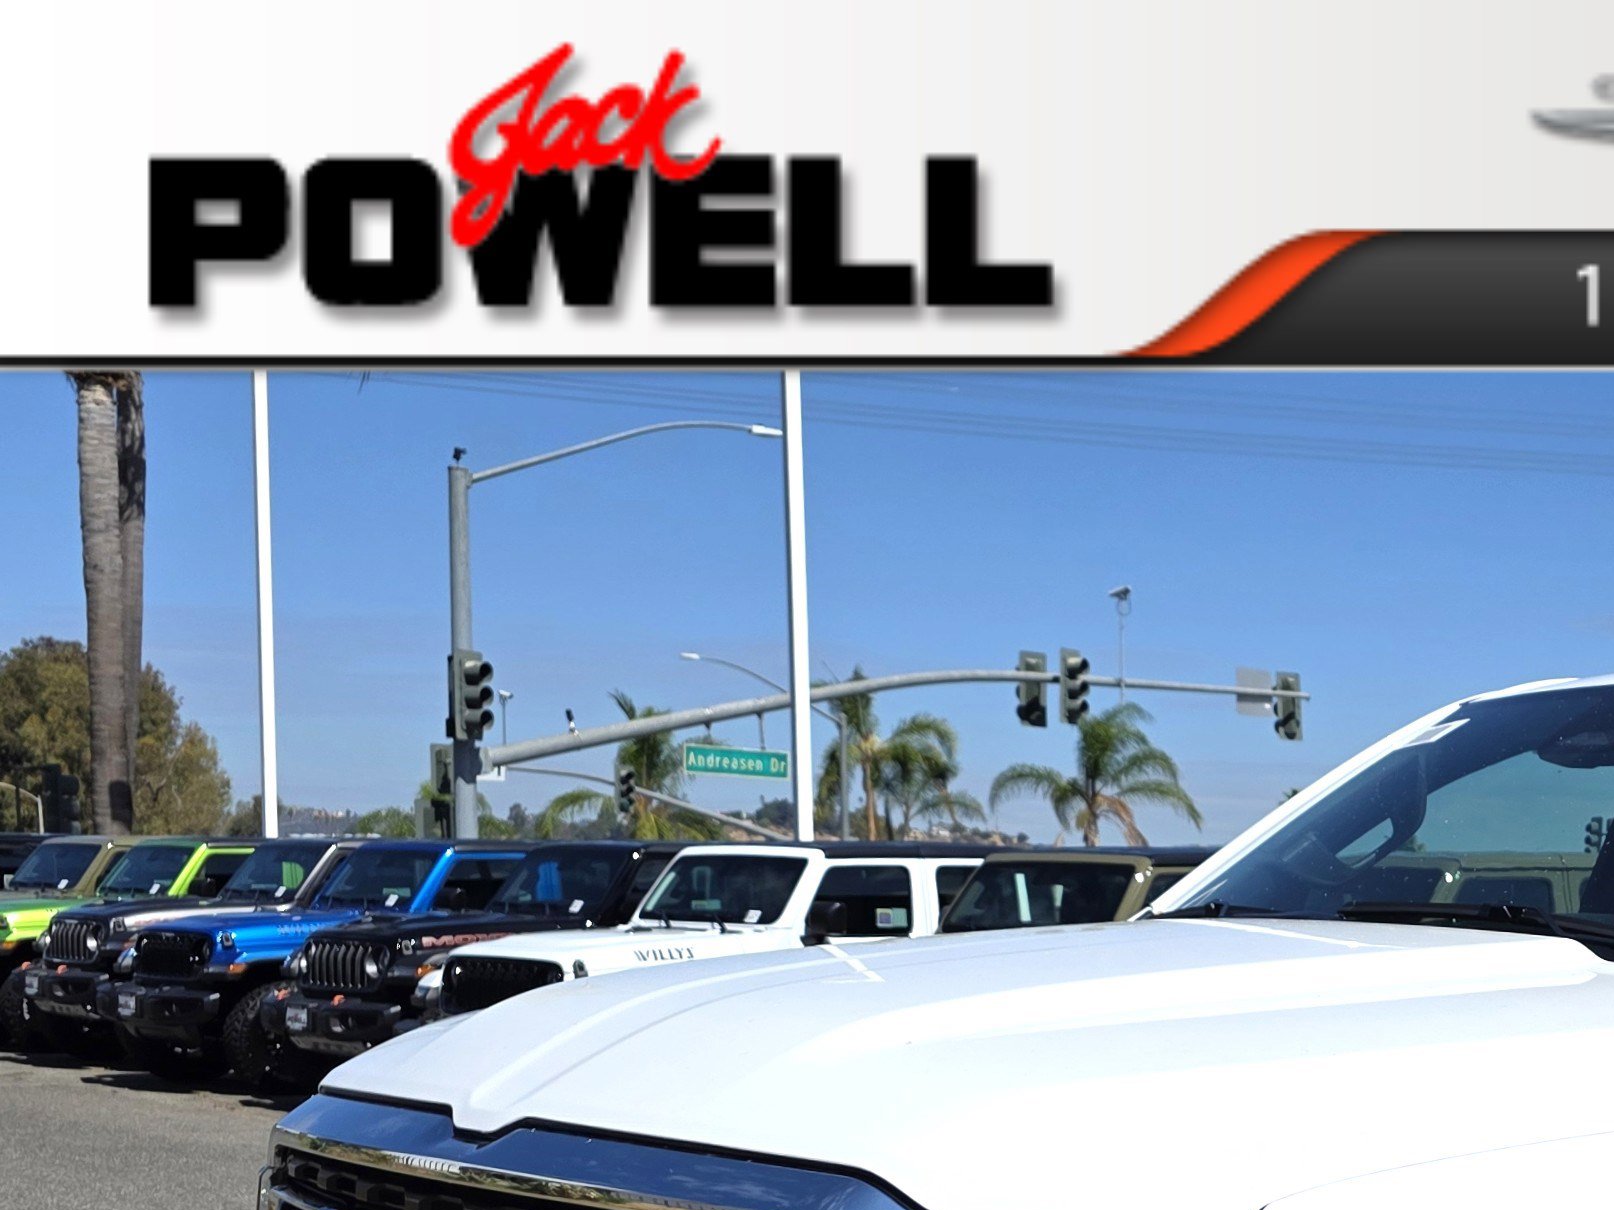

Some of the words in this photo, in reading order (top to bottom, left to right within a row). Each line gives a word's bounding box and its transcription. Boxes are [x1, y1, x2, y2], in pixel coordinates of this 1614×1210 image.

[688, 751, 764, 771] Andreasen
[770, 758, 786, 772] Dr
[633, 947, 694, 961] WILLYS
